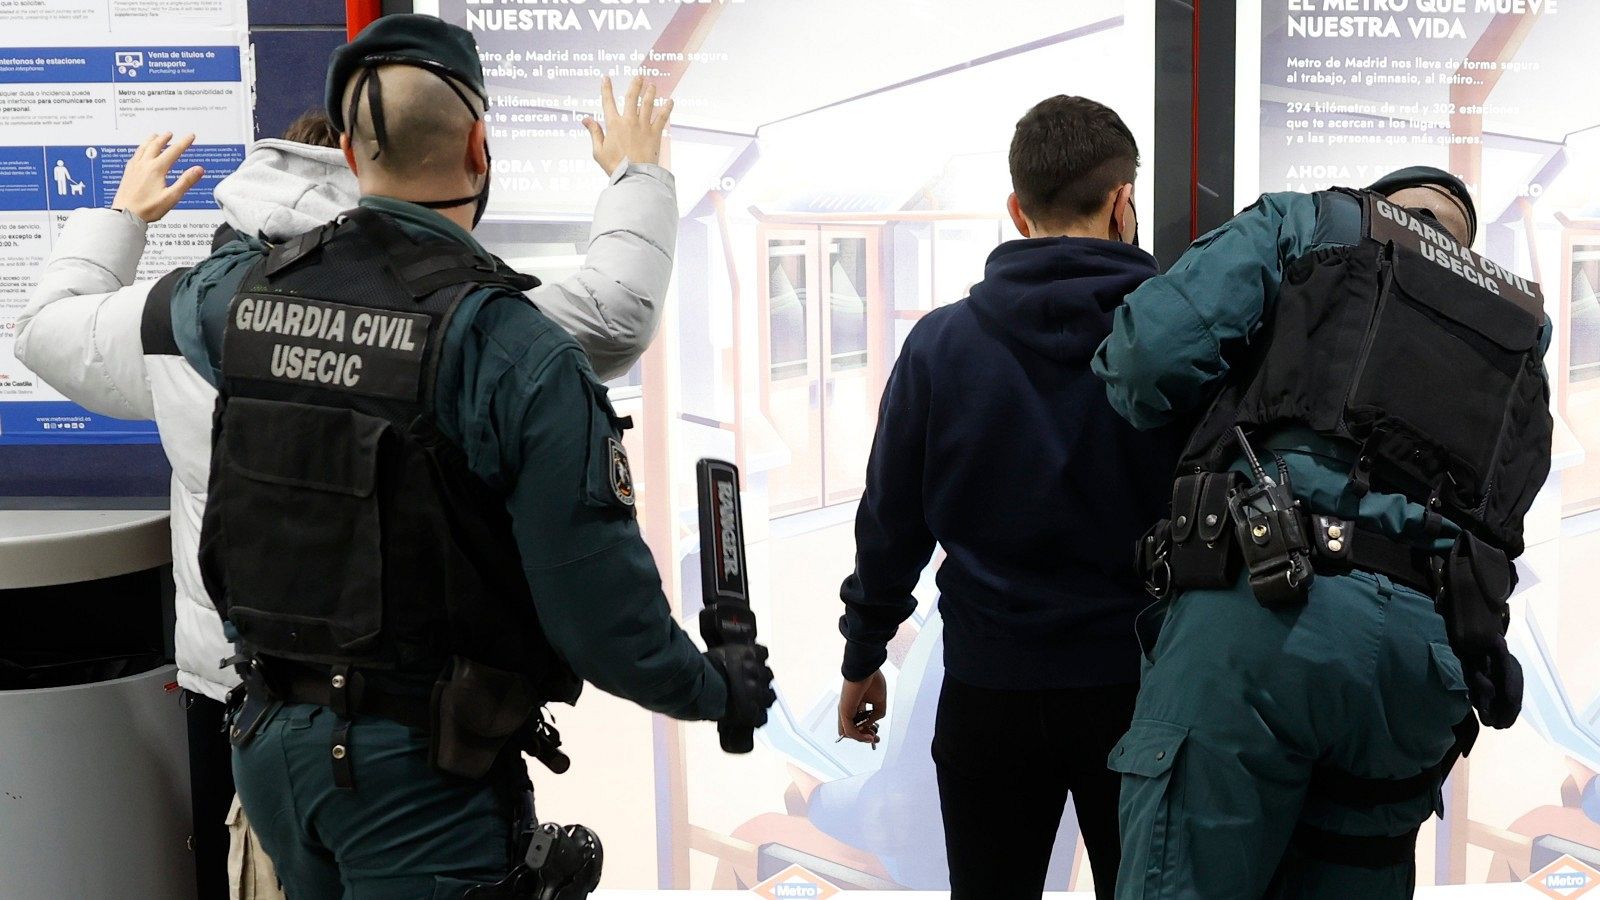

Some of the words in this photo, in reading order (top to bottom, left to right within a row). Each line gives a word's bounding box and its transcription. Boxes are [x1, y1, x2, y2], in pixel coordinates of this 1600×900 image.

[466, 8, 582, 32] NUESTRA
[587, 8, 652, 31] VIDA
[1287, 16, 1401, 38] NUESTRA
[1407, 17, 1467, 39] VIDA
[46, 57, 86, 65] estaciones
[148, 51, 168, 59] Venta
[477, 46, 501, 62] etro
[505, 47, 522, 62] de
[525, 46, 569, 62] Madrid
[573, 51, 594, 62] nos
[597, 47, 628, 62] lleva
[630, 48, 645, 63] de
[649, 48, 684, 62] forma
[687, 52, 729, 65] segura
[148, 60, 187, 68] transporte
[1287, 57, 1322, 69] Metro
[1325, 57, 1341, 69] de
[1345, 56, 1387, 69] Madrid
[1391, 60, 1411, 69] nos
[1415, 57, 1442, 70] lleva
[1444, 57, 1462, 70] de
[1463, 58, 1497, 70] forma
[1500, 61, 1540, 73] segura
[482, 65, 528, 79] trabajo,
[532, 65, 543, 77] al
[547, 66, 604, 80] gimnasio,
[608, 65, 619, 77] al
[623, 65, 671, 77] Retiro...
[1287, 72, 1297, 83] al
[1300, 72, 1346, 86] trabajo,
[1350, 72, 1362, 84] al
[1365, 72, 1421, 86] gimnasio,
[1424, 72, 1435, 84] al
[1439, 73, 1484, 85] Retiro...
[147, 89, 176, 97] garantiza
[497, 95, 560, 107] kilómetros
[562, 95, 579, 107] de
[1286, 102, 1312, 113] 294
[1315, 102, 1376, 113] kilómetros
[1380, 102, 1395, 113] de
[1399, 103, 1419, 114] red
[1422, 105, 1429, 116] y
[1432, 103, 1456, 114] 302
[1459, 103, 1519, 115] estaciones
[495, 112, 507, 123] te
[511, 113, 557, 123] acercan
[561, 114, 569, 123] a
[1286, 119, 1308, 130] que
[1312, 118, 1324, 129] te
[1328, 119, 1374, 129] acercan
[1378, 120, 1385, 129] a
[1388, 118, 1406, 129] los
[1408, 117, 1451, 131] lugares
[491, 126, 508, 138] las
[511, 128, 566, 140] personas
[1286, 135, 1293, 146] y
[1296, 136, 1304, 144] a
[1307, 133, 1325, 144] las
[1328, 135, 1382, 146] personas
[1385, 135, 1407, 146] que
[1411, 133, 1433, 144] más
[1436, 134, 1484, 146] quieres.
[1286, 165, 1351, 179] AHORA
[1355, 166, 1367, 179] Y
[1376, 200, 1476, 267] GUARDIA
[1480, 256, 1536, 298] CIVIL
[1419, 240, 1500, 295] USECIC
[235, 298, 346, 342] GUARDIA
[351, 313, 415, 351] CIVIL
[270, 343, 363, 387] USECIC
[717, 479, 739, 583] RANGER
[1547, 874, 1584, 888] Metro
[776, 884, 816, 897] Metro
